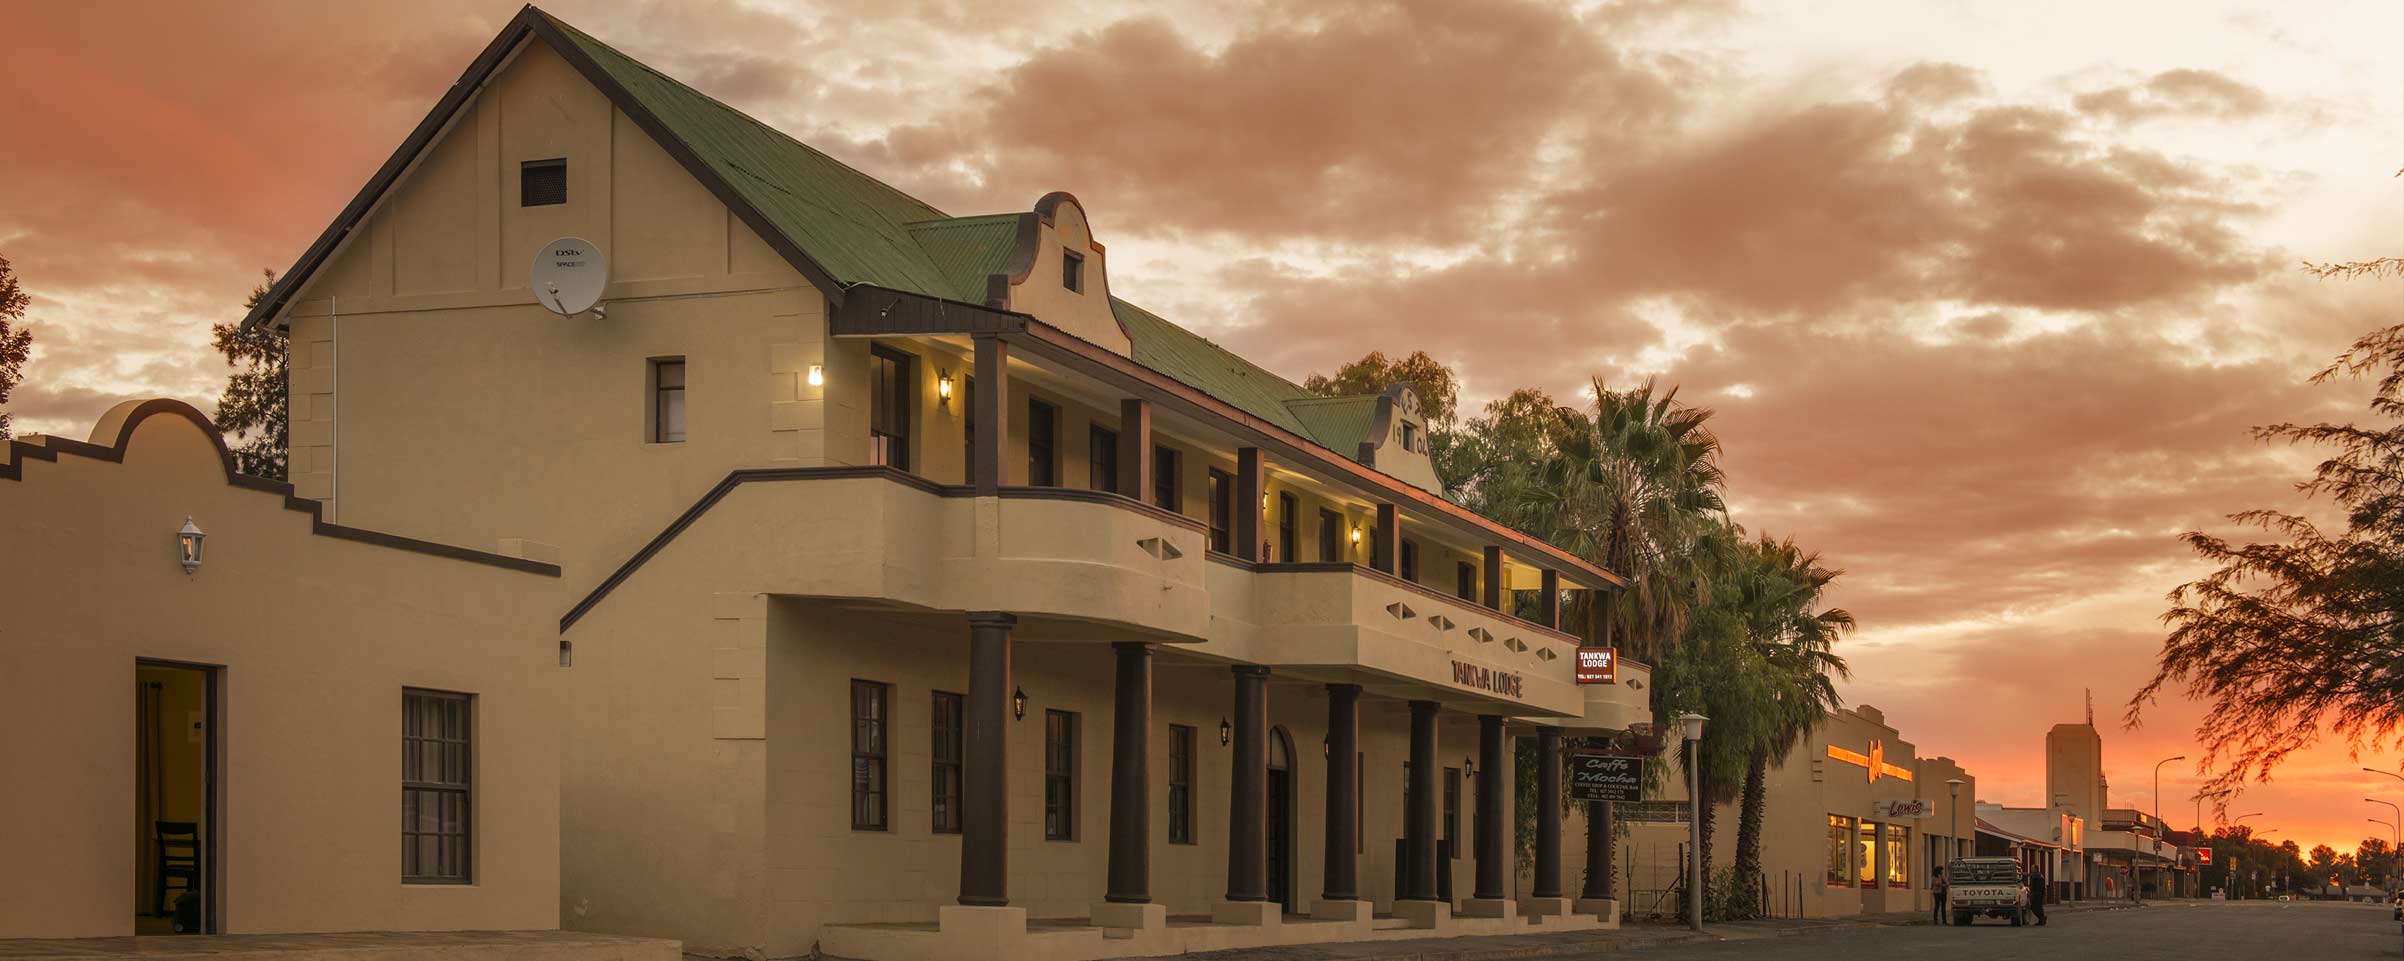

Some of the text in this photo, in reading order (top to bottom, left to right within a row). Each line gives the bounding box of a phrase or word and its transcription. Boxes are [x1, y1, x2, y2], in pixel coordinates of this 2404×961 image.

[1579, 652, 1611, 660] TANKWA
[1451, 660, 1523, 698] TANKWA LODGE
[1577, 772, 1637, 784] Mocha
[1889, 799, 1923, 817] Lewis
